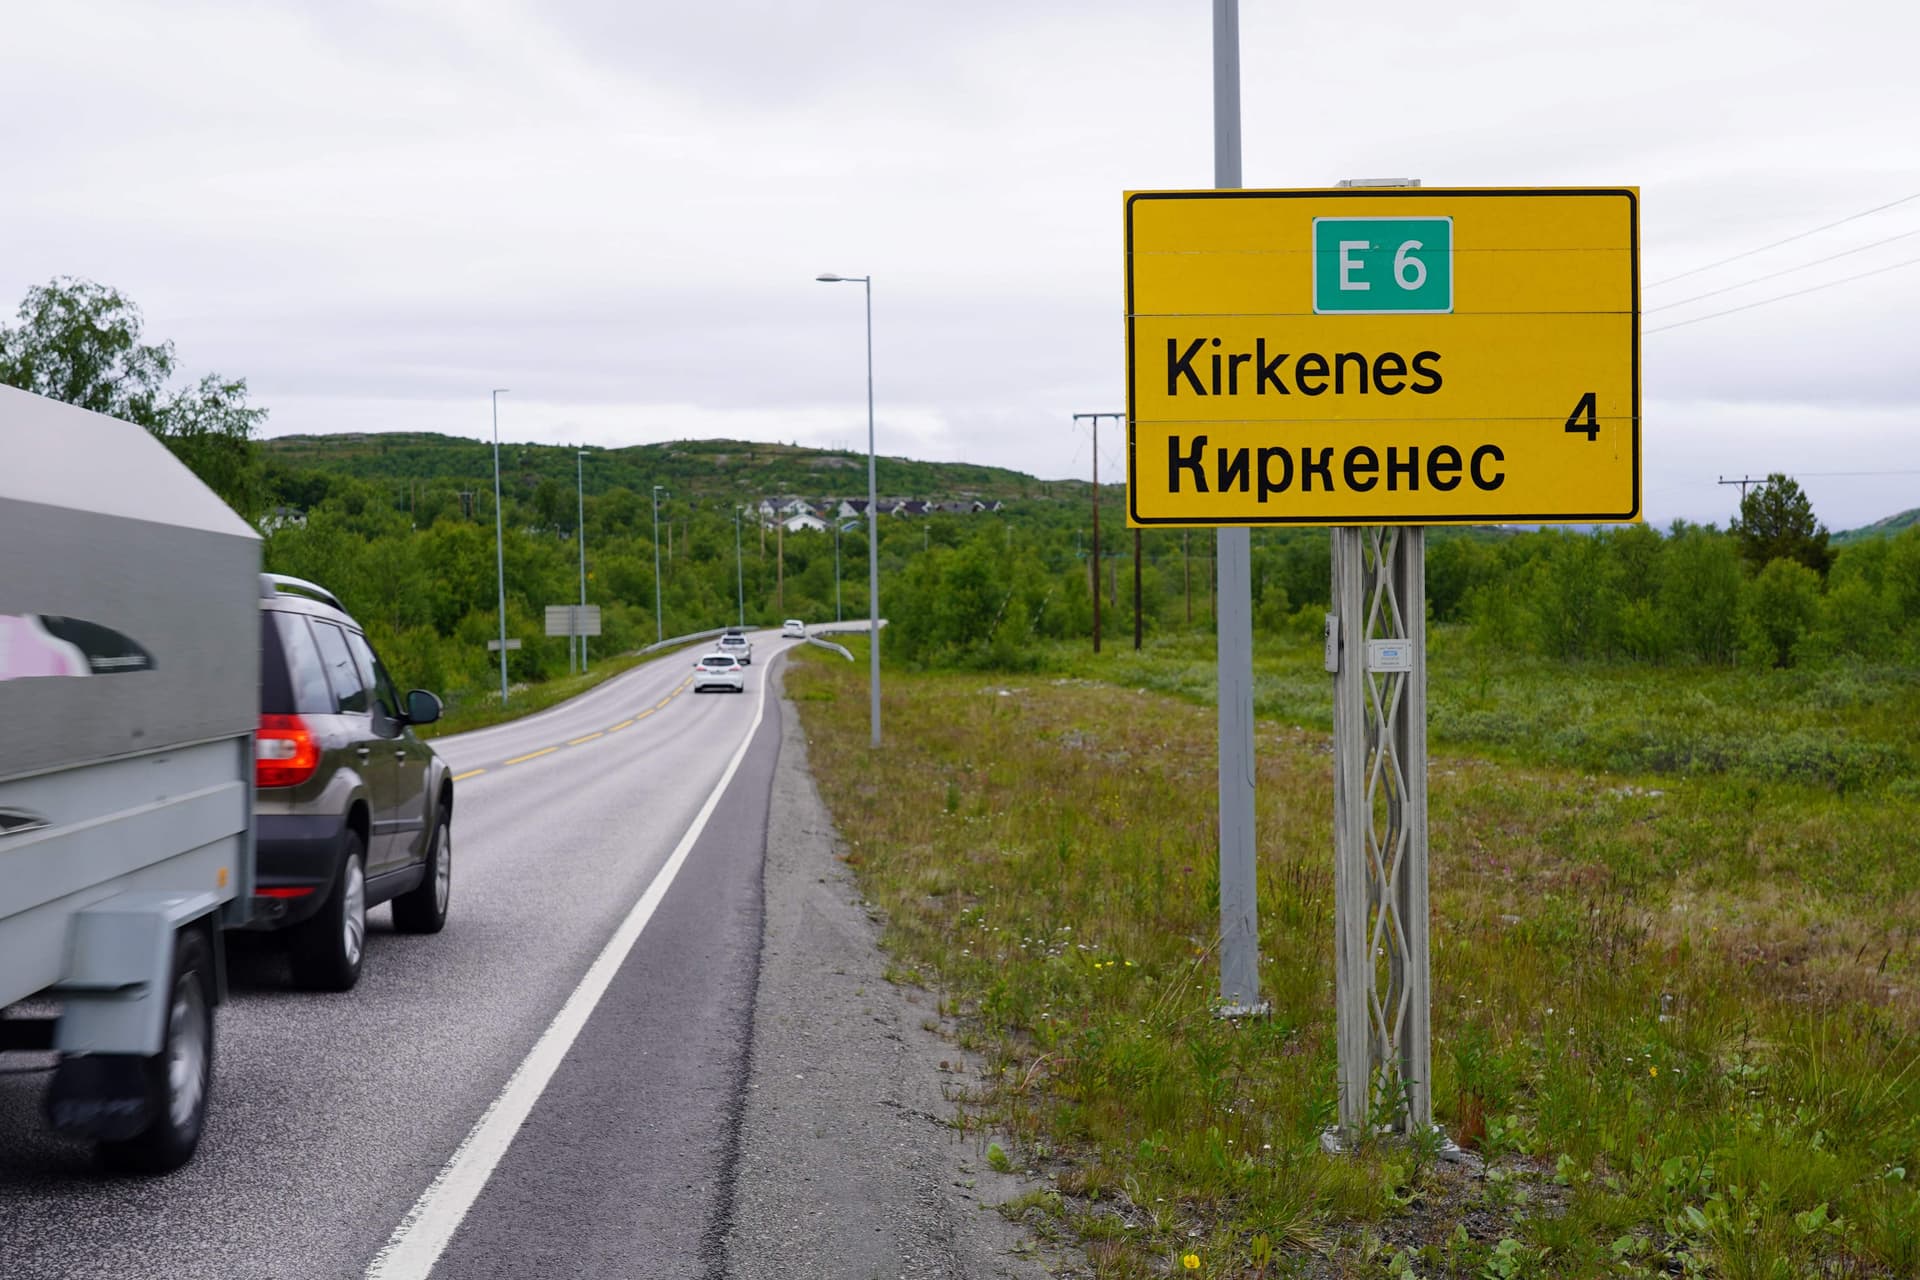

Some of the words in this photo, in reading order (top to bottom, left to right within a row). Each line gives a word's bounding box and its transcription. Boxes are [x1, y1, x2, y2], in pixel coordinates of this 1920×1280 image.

[1339, 240, 1371, 291] E
[1393, 239, 1428, 291] 6
[1167, 336, 1443, 397] Kirkenes
[1564, 391, 1601, 442] 4
[1168, 435, 1506, 503] Киркенес
